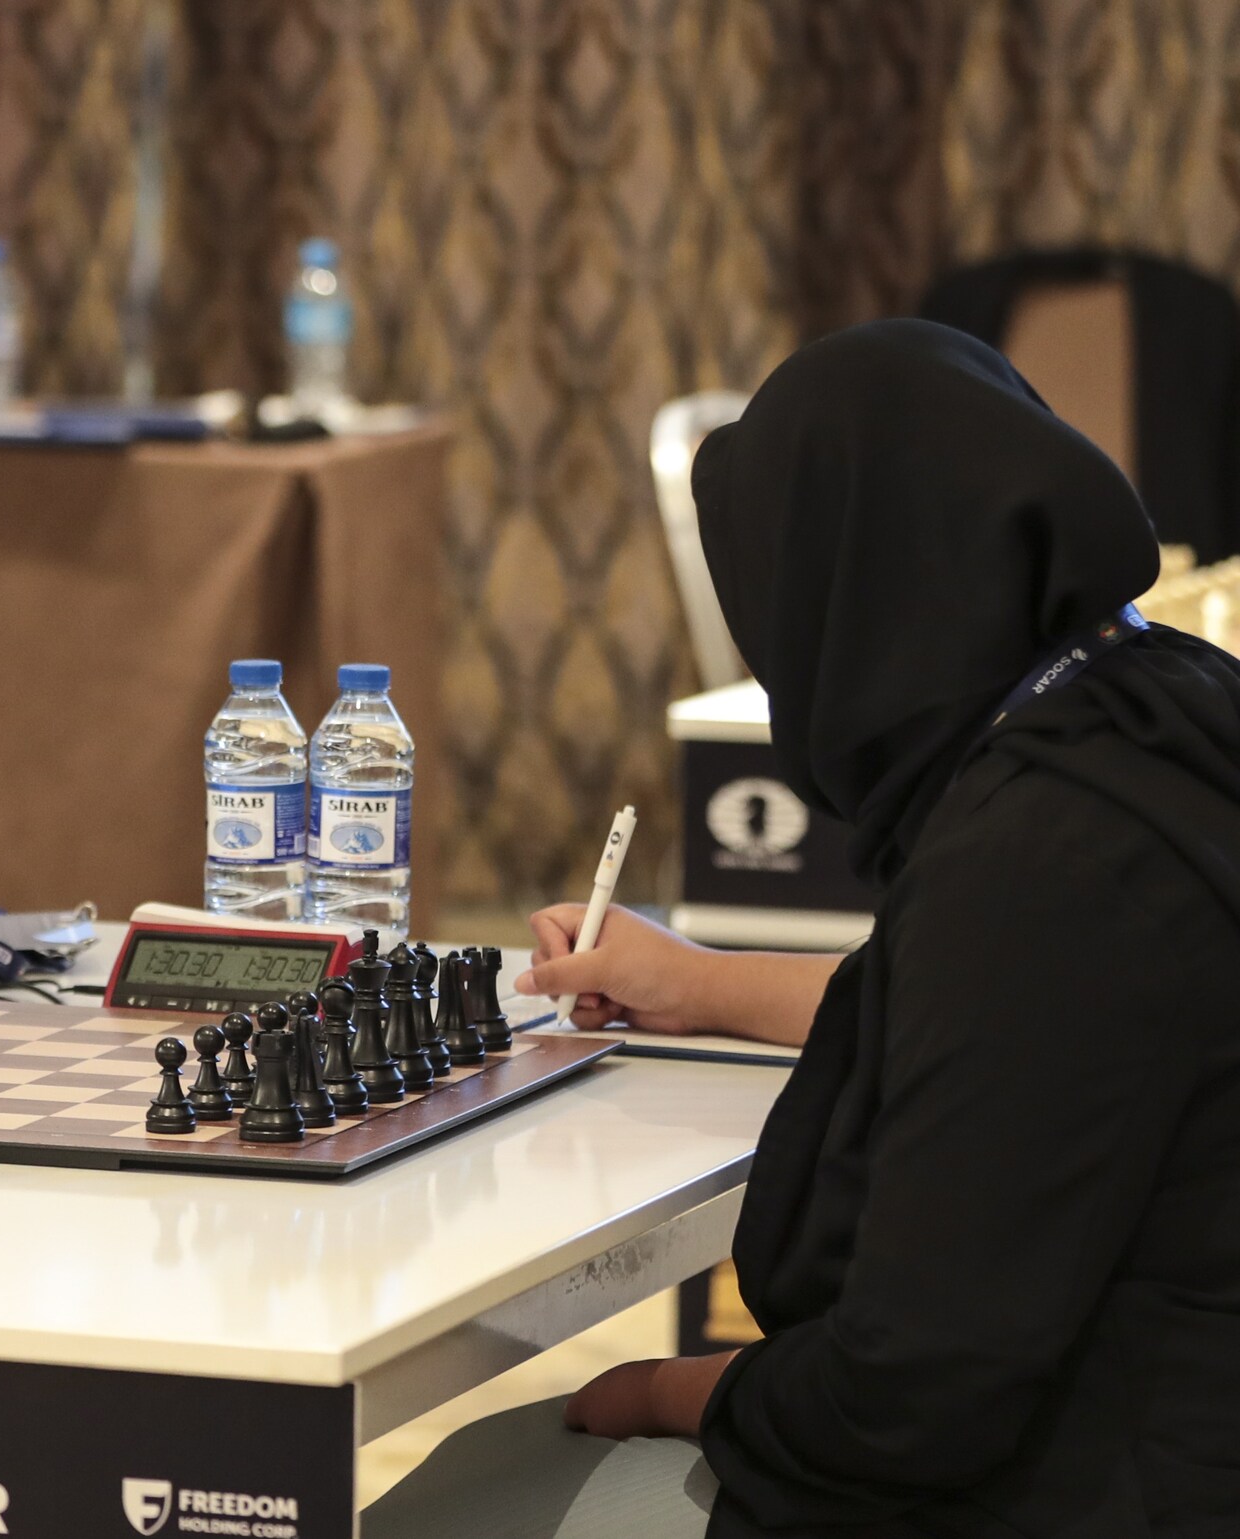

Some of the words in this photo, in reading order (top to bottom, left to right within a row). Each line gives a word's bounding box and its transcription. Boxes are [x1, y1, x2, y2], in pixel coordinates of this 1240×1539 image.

[1032, 656, 1072, 694] SOCAR
[178, 1488, 298, 1521] FREEDOM
[178, 1516, 251, 1537] HOLDING
